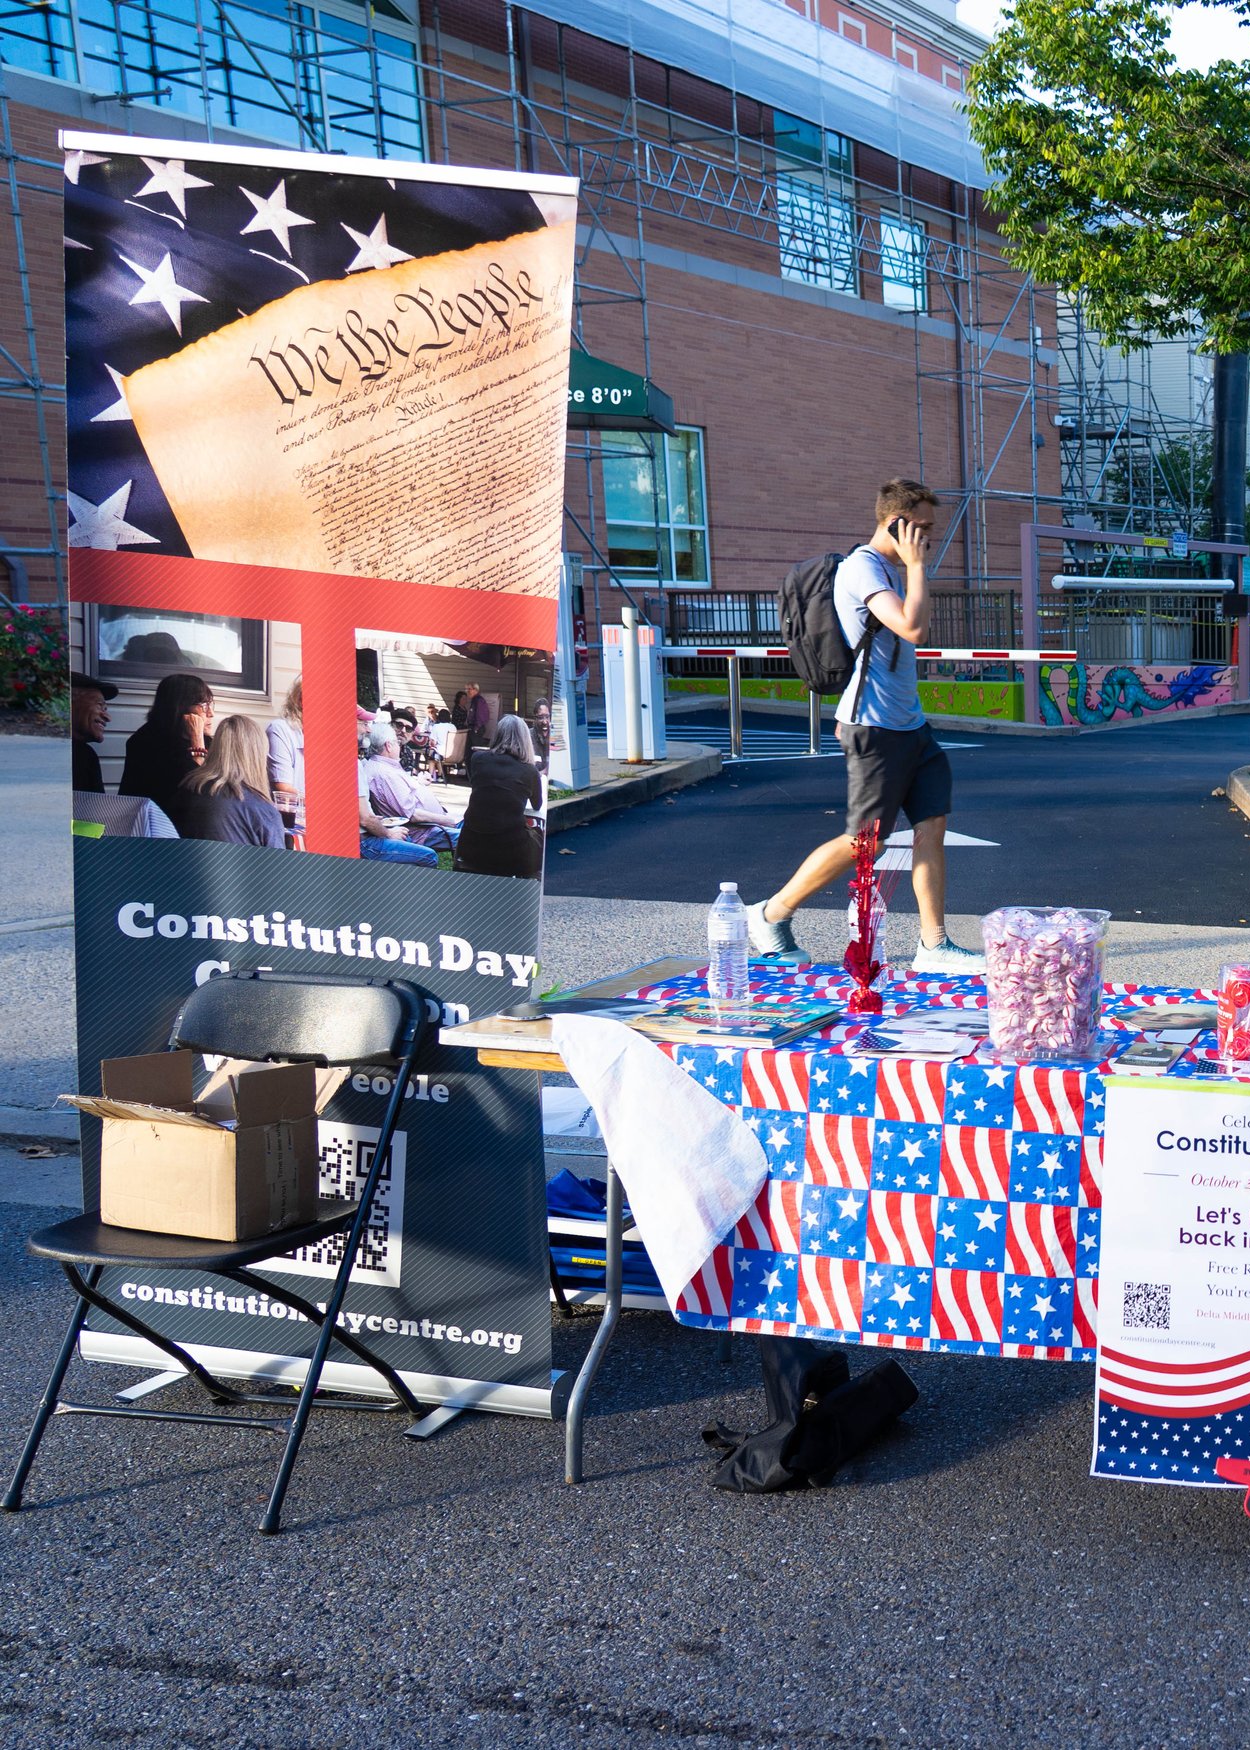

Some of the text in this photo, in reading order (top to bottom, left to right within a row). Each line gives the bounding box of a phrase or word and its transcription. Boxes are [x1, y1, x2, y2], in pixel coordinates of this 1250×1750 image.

[248, 330, 346, 413] We
[336, 309, 412, 384] the
[394, 262, 544, 367] People
[116, 902, 536, 988] Constitution Day
[1190, 1172, 1242, 1189] October
[1196, 1206, 1241, 1225] Let's
[1179, 1227, 1236, 1248] back
[1208, 1261, 1239, 1275] Free
[120, 1281, 523, 1354] constitutionycentre.org
[1195, 1309, 1221, 1319] Delta
